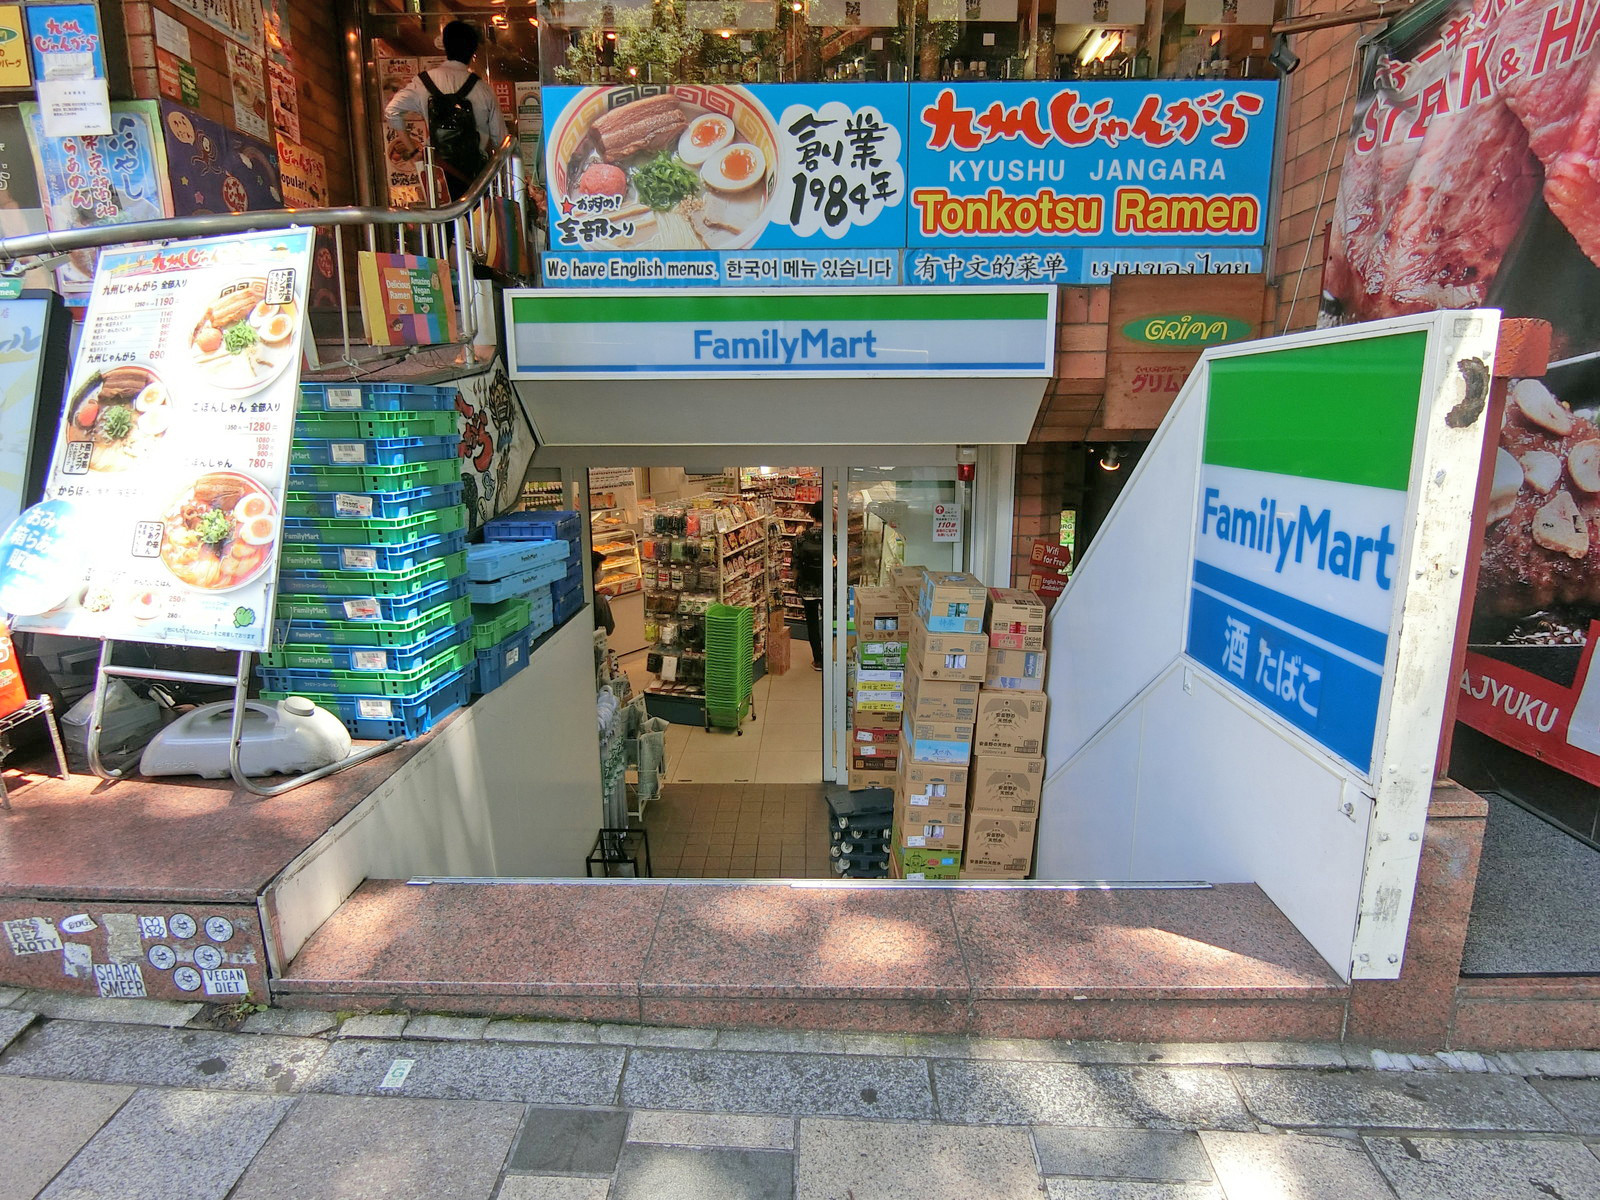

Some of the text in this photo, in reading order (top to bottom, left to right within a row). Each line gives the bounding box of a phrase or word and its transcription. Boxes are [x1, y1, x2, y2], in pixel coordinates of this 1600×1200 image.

[46, 17, 82, 35] 九州
[34, 35, 98, 52] じゃんがら
[1355, 36, 1500, 155] STEAK
[1499, 47, 1525, 88] &
[922, 88, 1264, 152] 九州じゃんがら
[788, 112, 888, 172] 創業
[63, 138, 94, 209] らあめん
[949, 158, 1227, 182] KYUSHU JANGARA
[281, 173, 307, 191] opular!
[790, 170, 898, 227] 1984年
[914, 190, 1260, 235] Tonkotsu Ramen
[556, 217, 634, 244] 全部入り
[547, 260, 568, 277] We
[573, 260, 606, 277] have
[610, 260, 663, 279] English
[727, 260, 892, 279] 한국어 메뉴 있습니다
[914, 255, 1067, 279] 有中文的菜单
[1092, 254, 1250, 276] เมนของไทย
[102, 279, 188, 296] 九州じゃんがら 全部入り
[278, 271, 287, 300] トンコツ
[386, 279, 410, 290] Delicious
[410, 276, 431, 288] Amazing
[390, 290, 411, 300] Ramen
[413, 286, 431, 297] Vegan
[414, 294, 434, 304] Ramen
[1145, 315, 1228, 340] GRIMM
[693, 328, 877, 364] FamilyMart
[86, 352, 137, 364] 九州じゃんがら
[1132, 374, 1188, 393] グリム
[250, 402, 281, 413] 全部入り
[284, 532, 320, 541] FamilyMart
[1202, 487, 1395, 590] FamilyMart
[286, 556, 322, 566] FamilyMart
[1043, 555, 1066, 567] for Free
[293, 606, 328, 615] FamilyMart
[298, 656, 333, 665] FamilyMart
[1221, 614, 1321, 718] 酒 たばこ
[1460, 668, 1559, 733] AJYUKU
[96, 964, 140, 981] SHARK
[206, 969, 244, 981] VEGAN
[214, 982, 241, 993] DIET
